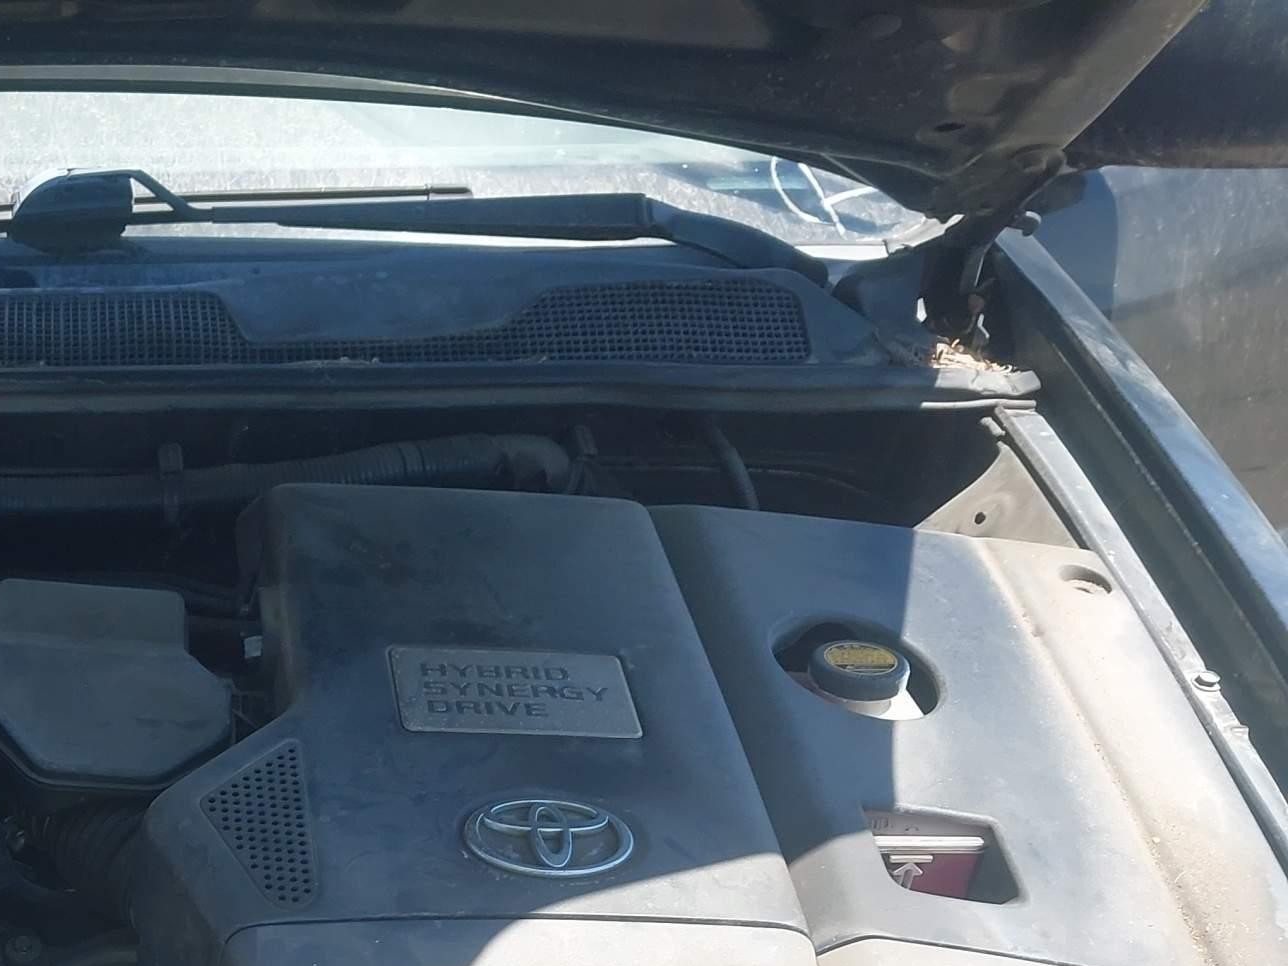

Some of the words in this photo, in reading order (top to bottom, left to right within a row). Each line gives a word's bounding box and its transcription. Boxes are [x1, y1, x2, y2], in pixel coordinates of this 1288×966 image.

[419, 663, 571, 681] HYBRID
[422, 680, 609, 701] SYNERGY
[427, 700, 549, 718] DRIVE
